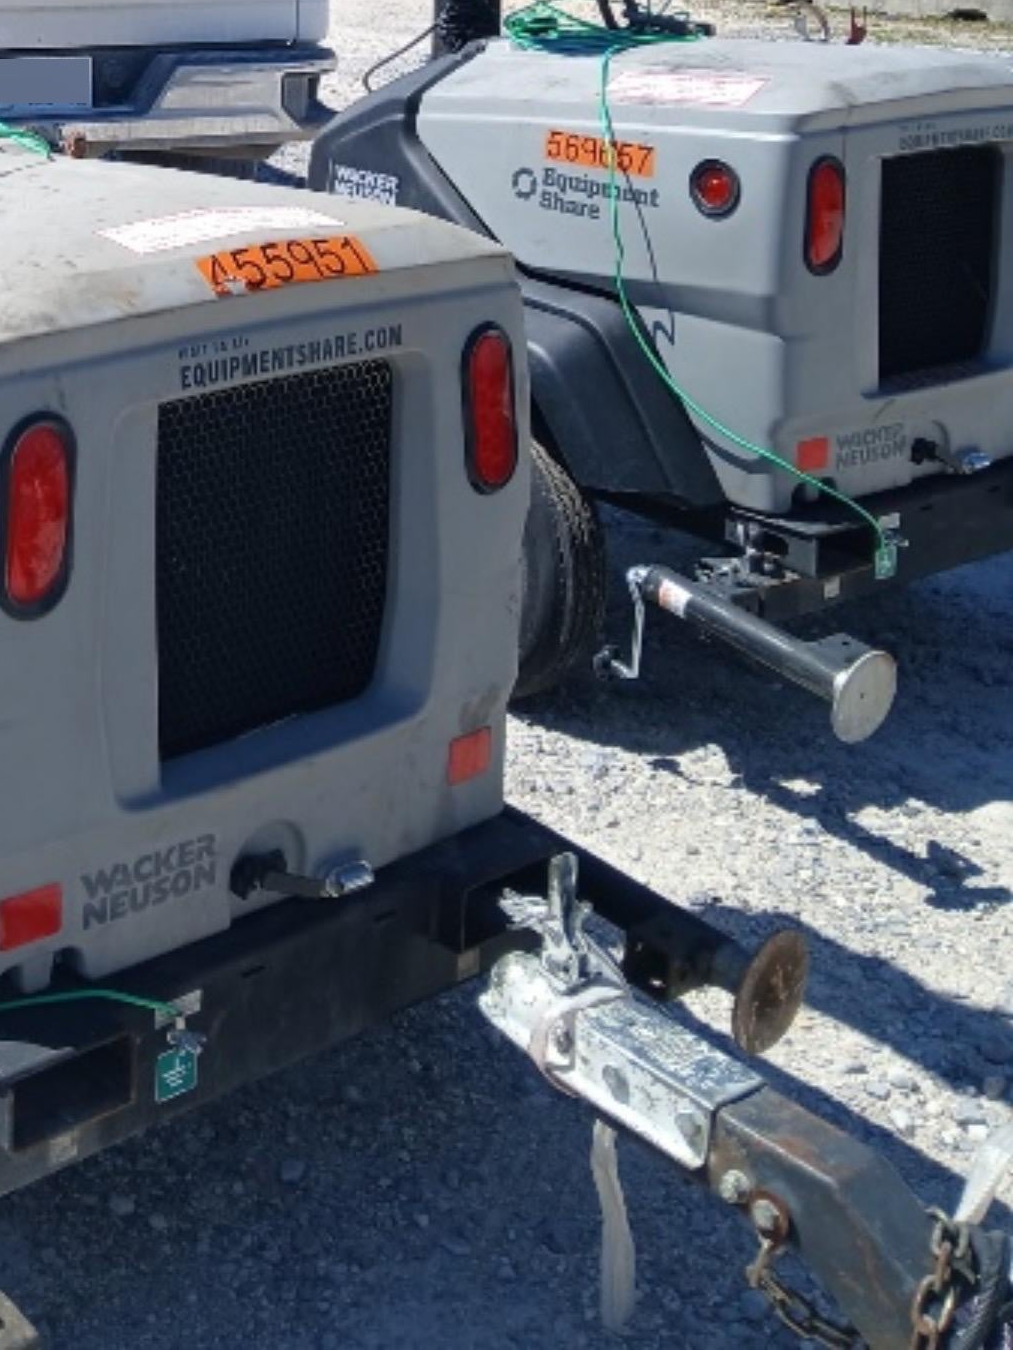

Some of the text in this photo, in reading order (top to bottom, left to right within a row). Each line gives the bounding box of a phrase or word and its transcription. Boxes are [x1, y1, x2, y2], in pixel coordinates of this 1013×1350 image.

[334, 163, 400, 190] WACKER
[542, 167, 661, 208] Equipment
[539, 189, 601, 220] Share
[180, 324, 404, 390] EQUIPMENTSHARE.COM
[80, 833, 216, 900] WACKER
[82, 860, 216, 931] NEUSON
